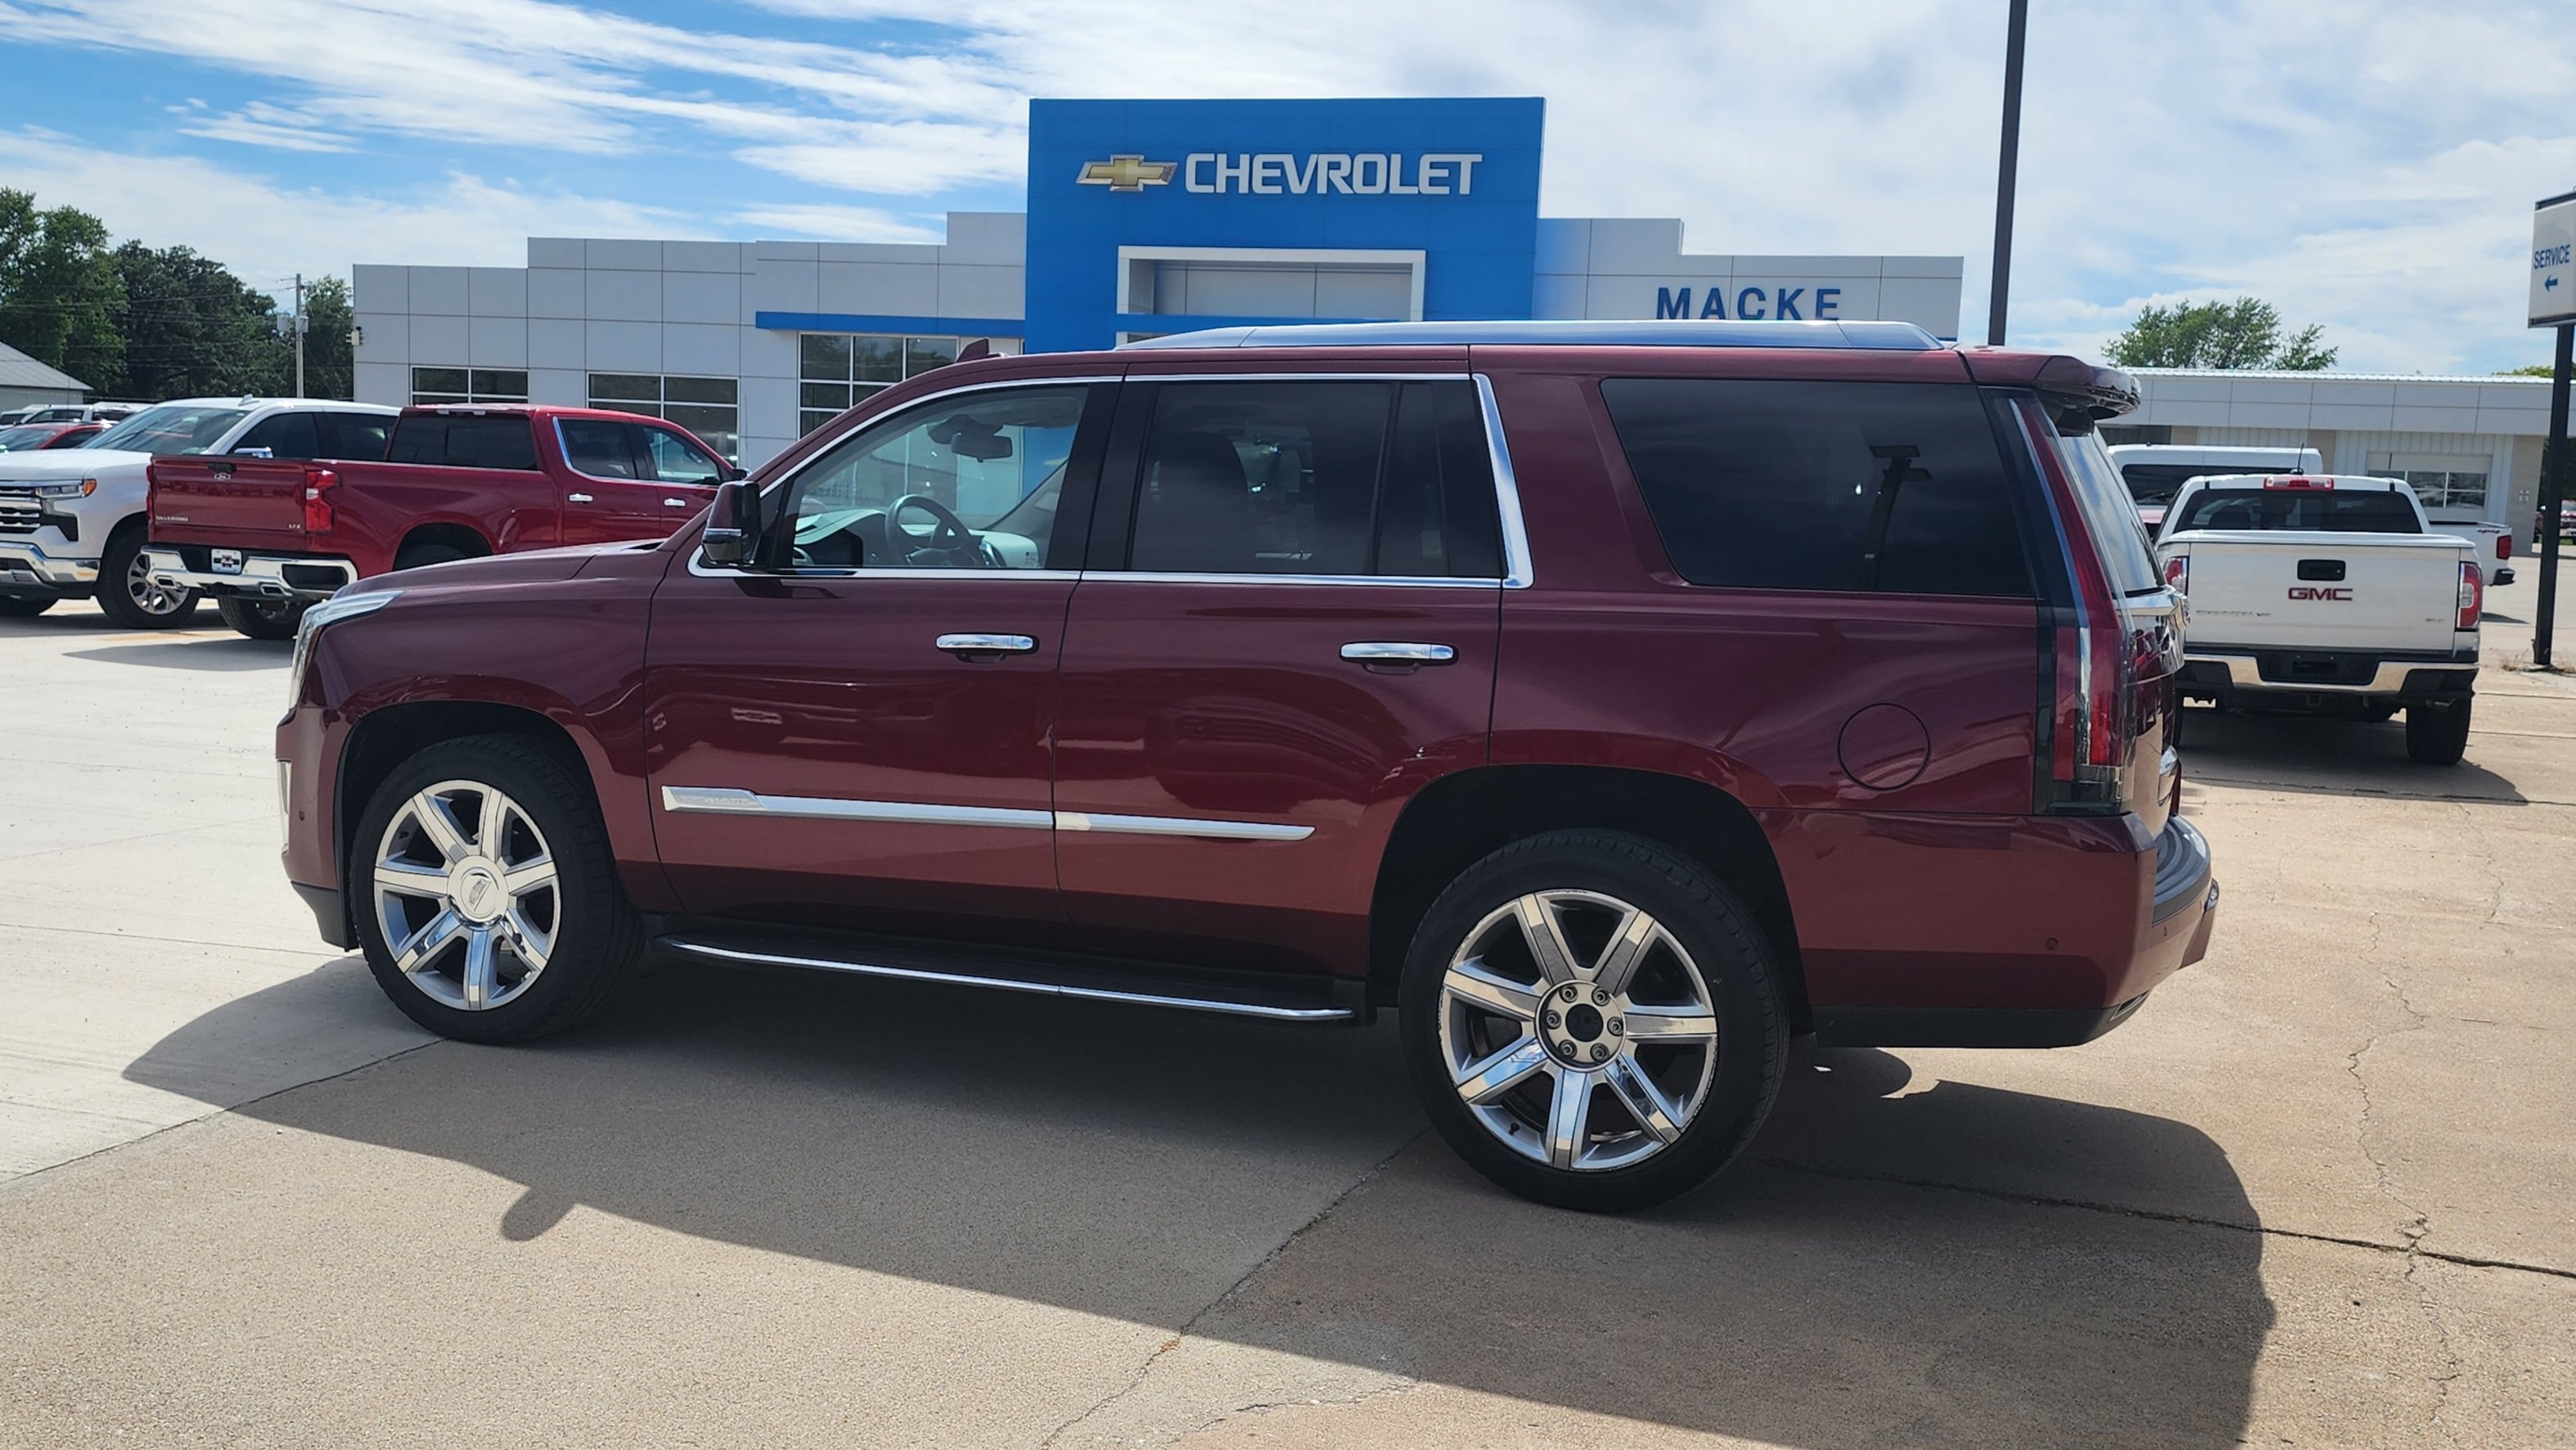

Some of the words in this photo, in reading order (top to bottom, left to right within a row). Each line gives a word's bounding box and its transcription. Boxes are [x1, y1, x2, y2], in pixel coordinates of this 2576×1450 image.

[1185, 153, 1483, 195] CHEVROLET
[2533, 244, 2571, 270] SERVICE
[1655, 286, 1841, 321] MACKE
[2288, 587, 2353, 601] GMC
